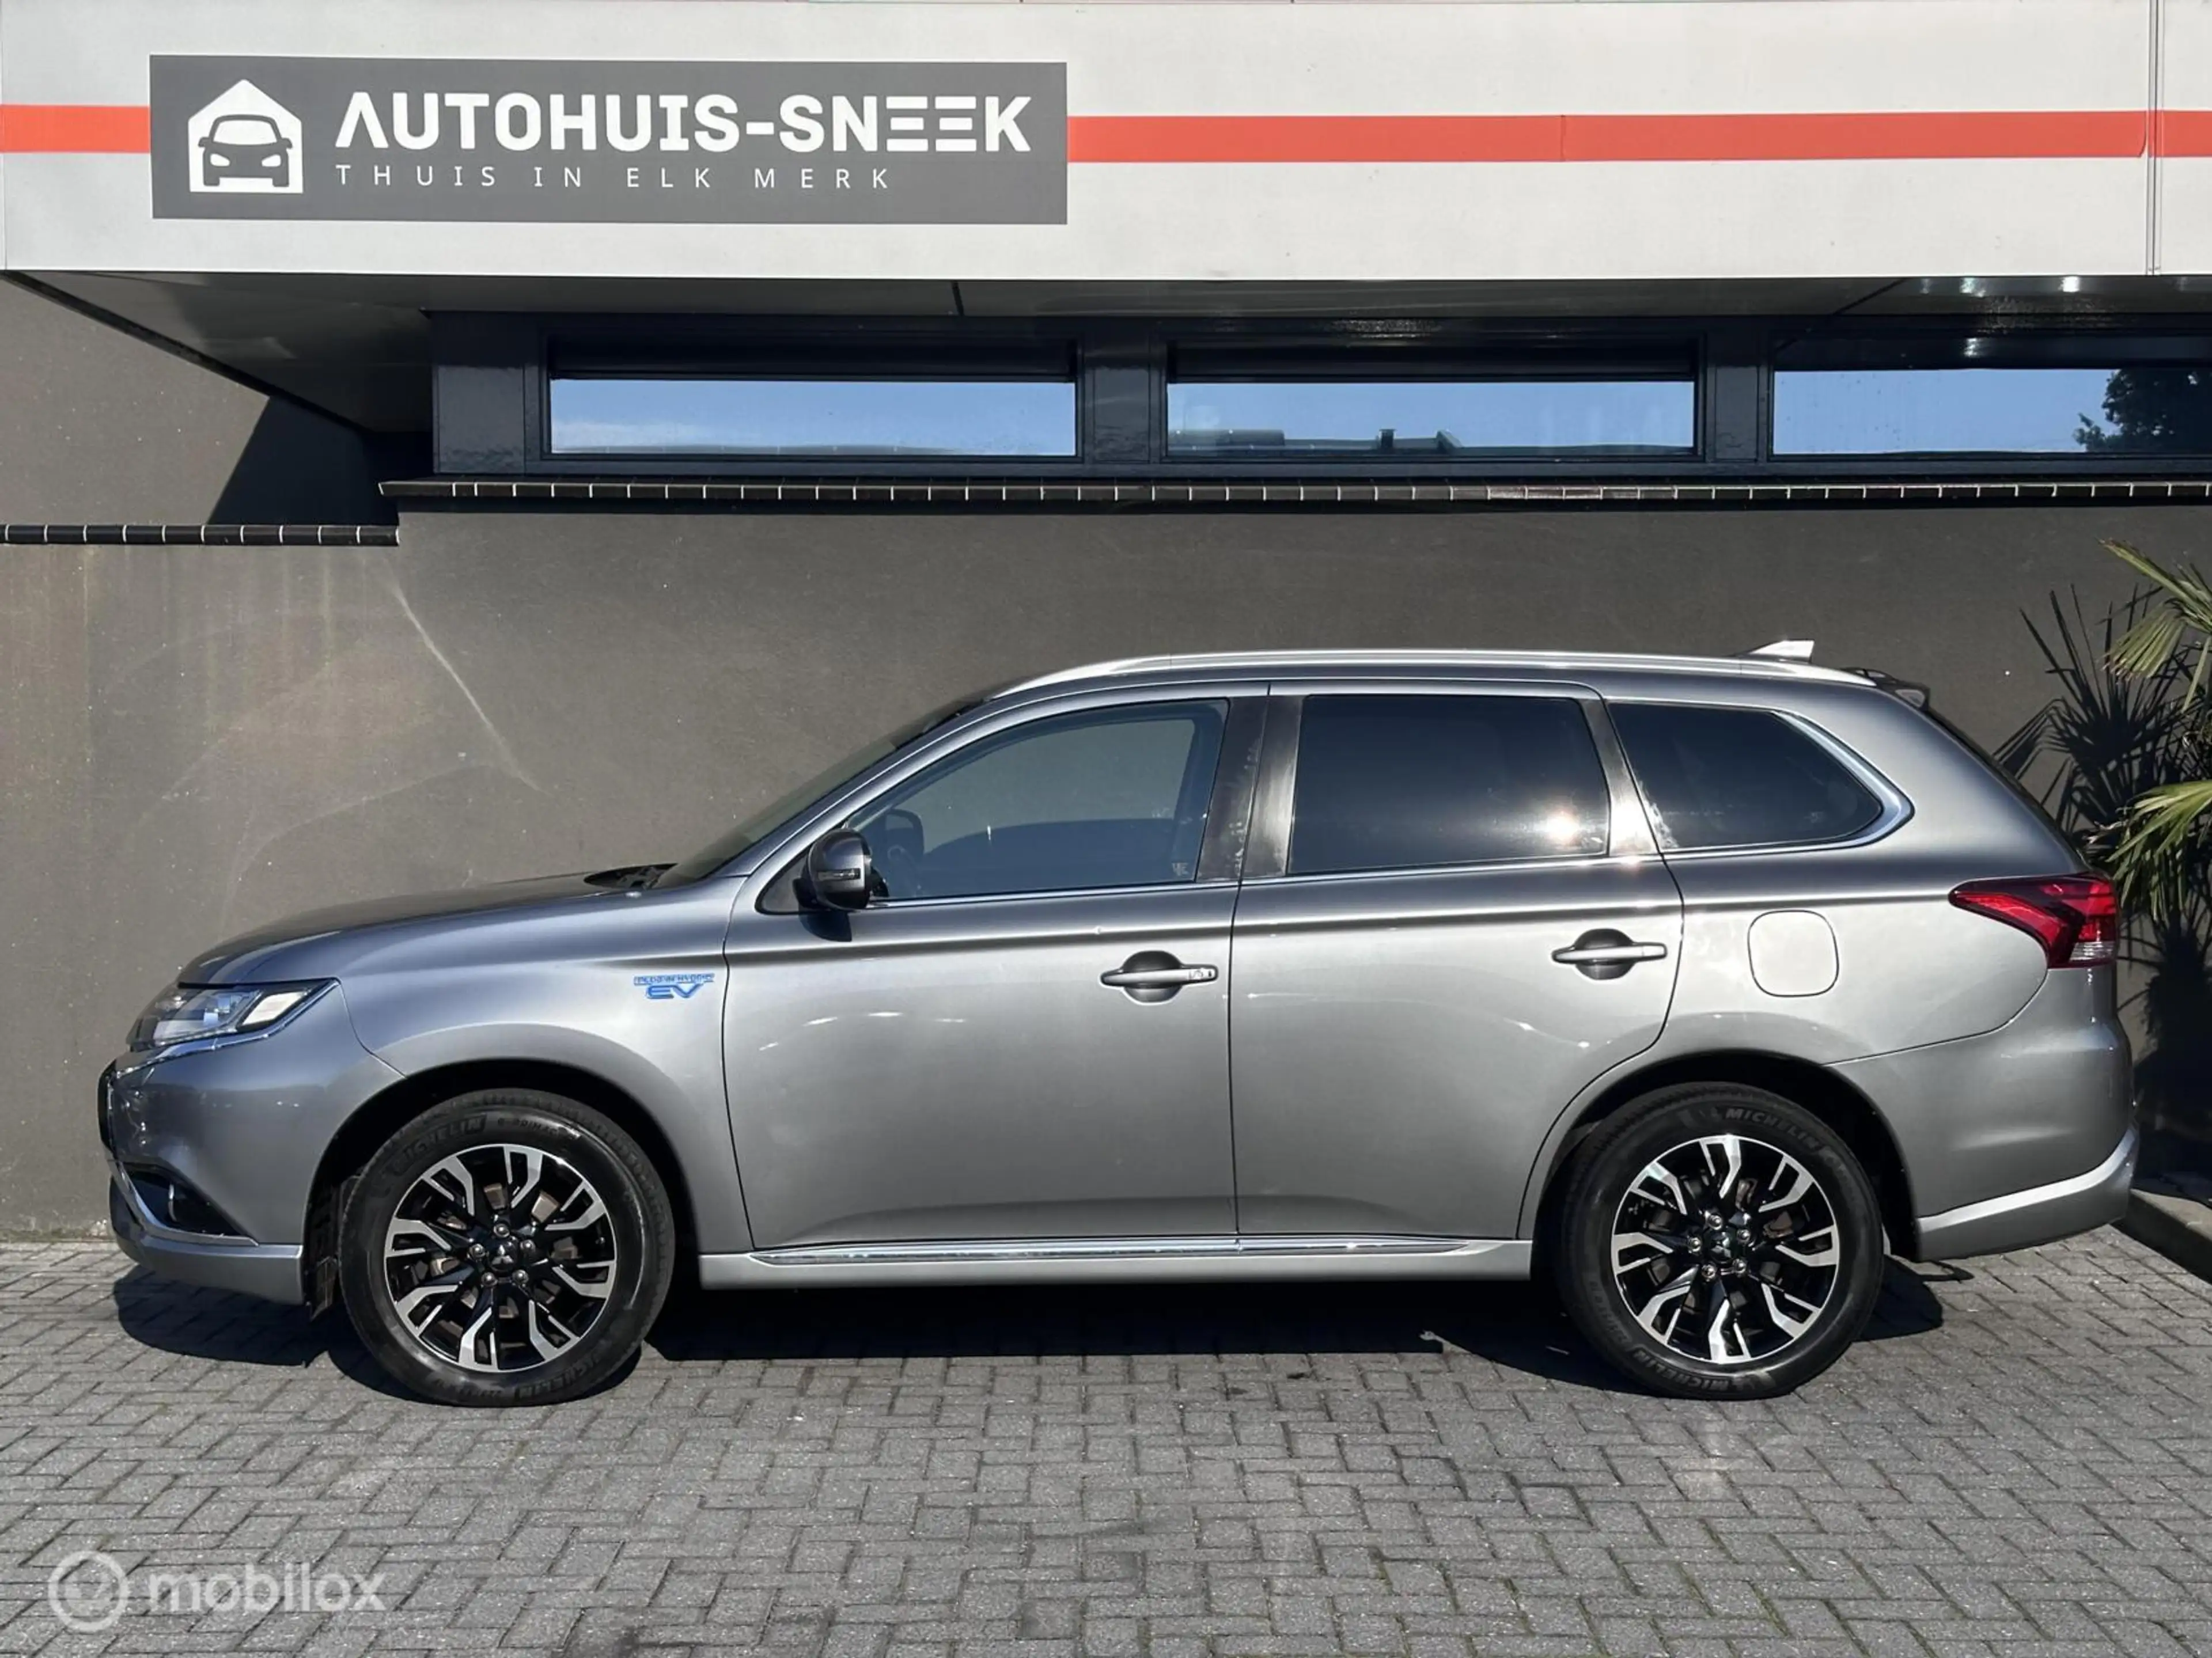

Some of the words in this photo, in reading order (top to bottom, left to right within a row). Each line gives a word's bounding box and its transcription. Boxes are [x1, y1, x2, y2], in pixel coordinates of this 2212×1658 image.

[335, 92, 1032, 153] AUTOHUIS-SNEEK
[335, 164, 495, 187] THUIS
[534, 166, 581, 188] IN
[627, 167, 711, 188] ELK
[755, 168, 888, 189] MERK
[647, 984, 703, 999] EV
[1725, 1107, 1820, 1151] MICHELIN
